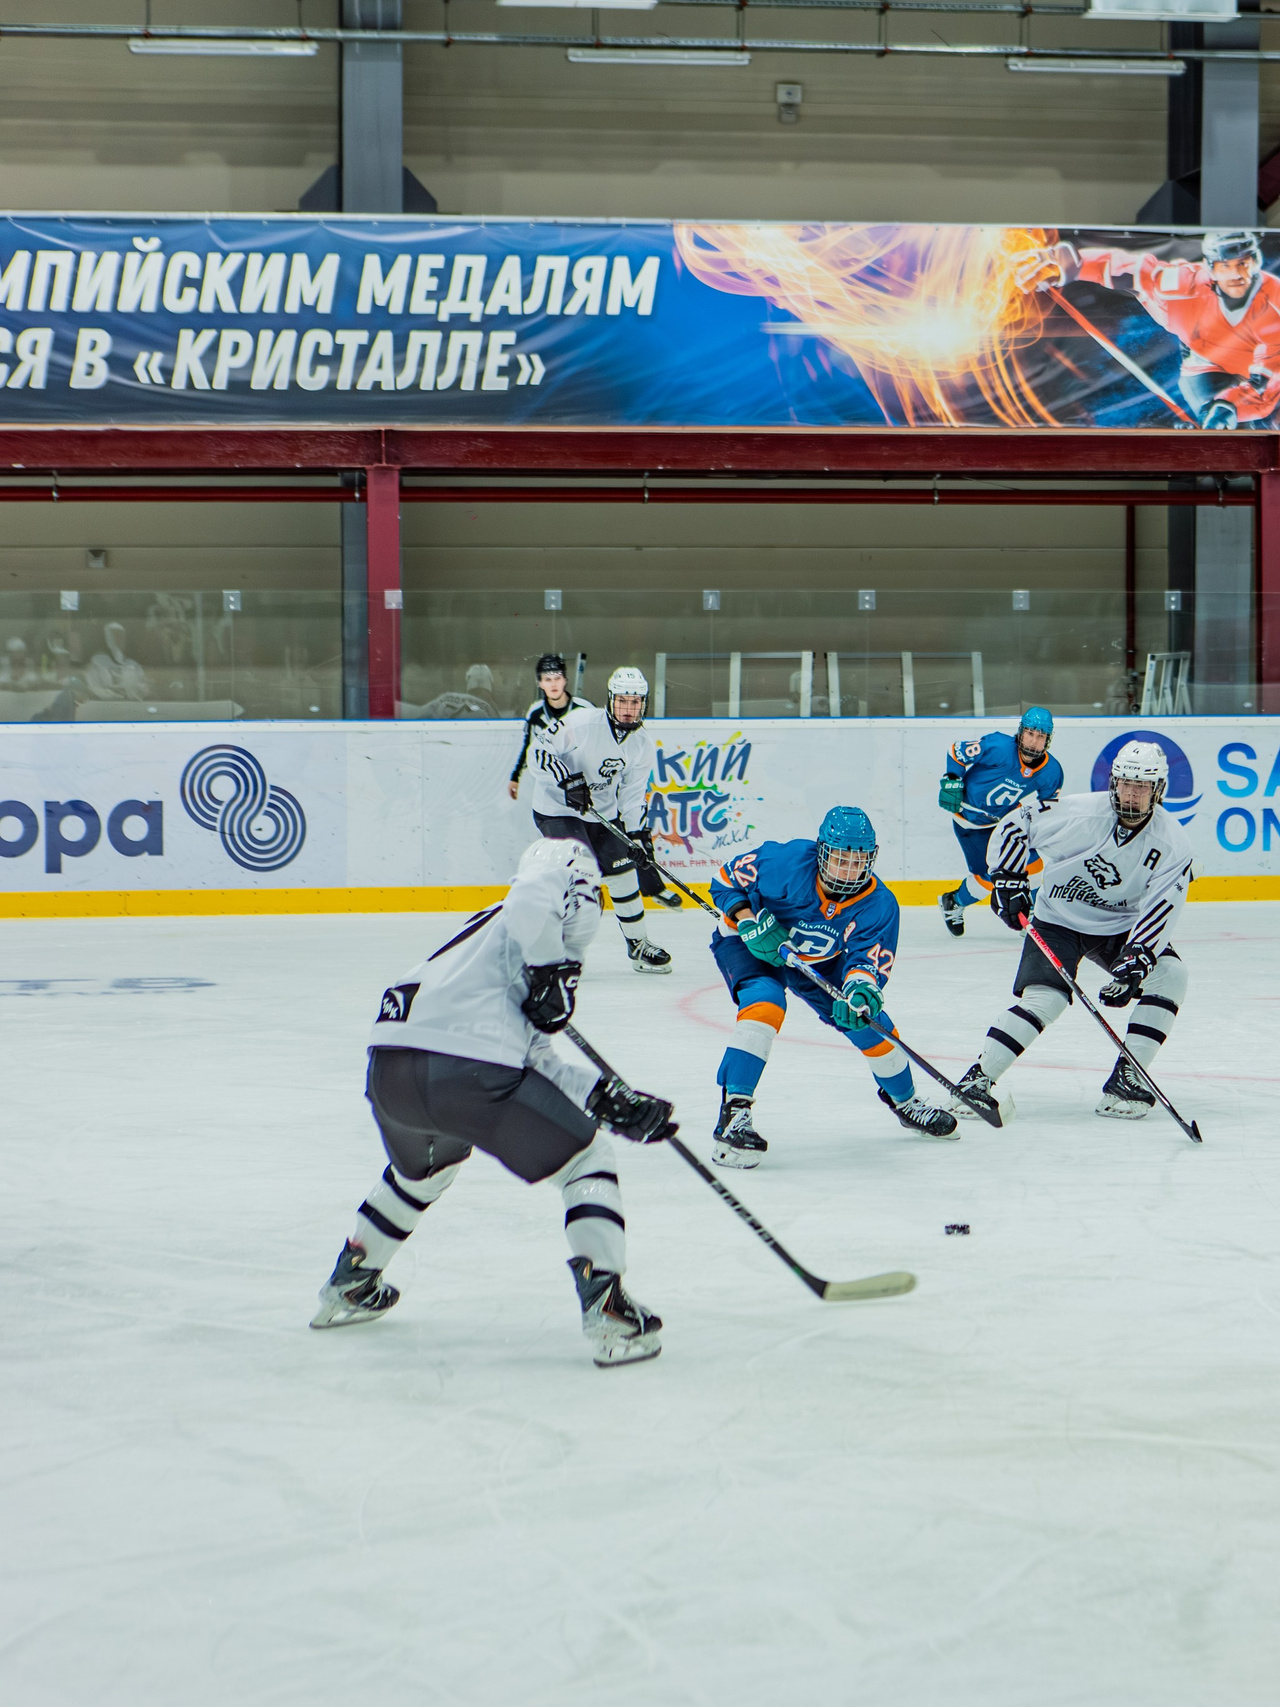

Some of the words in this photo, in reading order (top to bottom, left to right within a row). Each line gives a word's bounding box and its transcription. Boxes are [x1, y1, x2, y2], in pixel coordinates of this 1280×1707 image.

[356, 253, 661, 323] МЕДАЛЯМ
[69, 328, 113, 390] В
[133, 328, 547, 392] «КРИСТАЛЛЕ»
[656, 739, 752, 783] КИЙ
[1143, 847, 1162, 871] A
[995, 879, 1030, 889] CCM
[867, 943, 896, 980] 42
